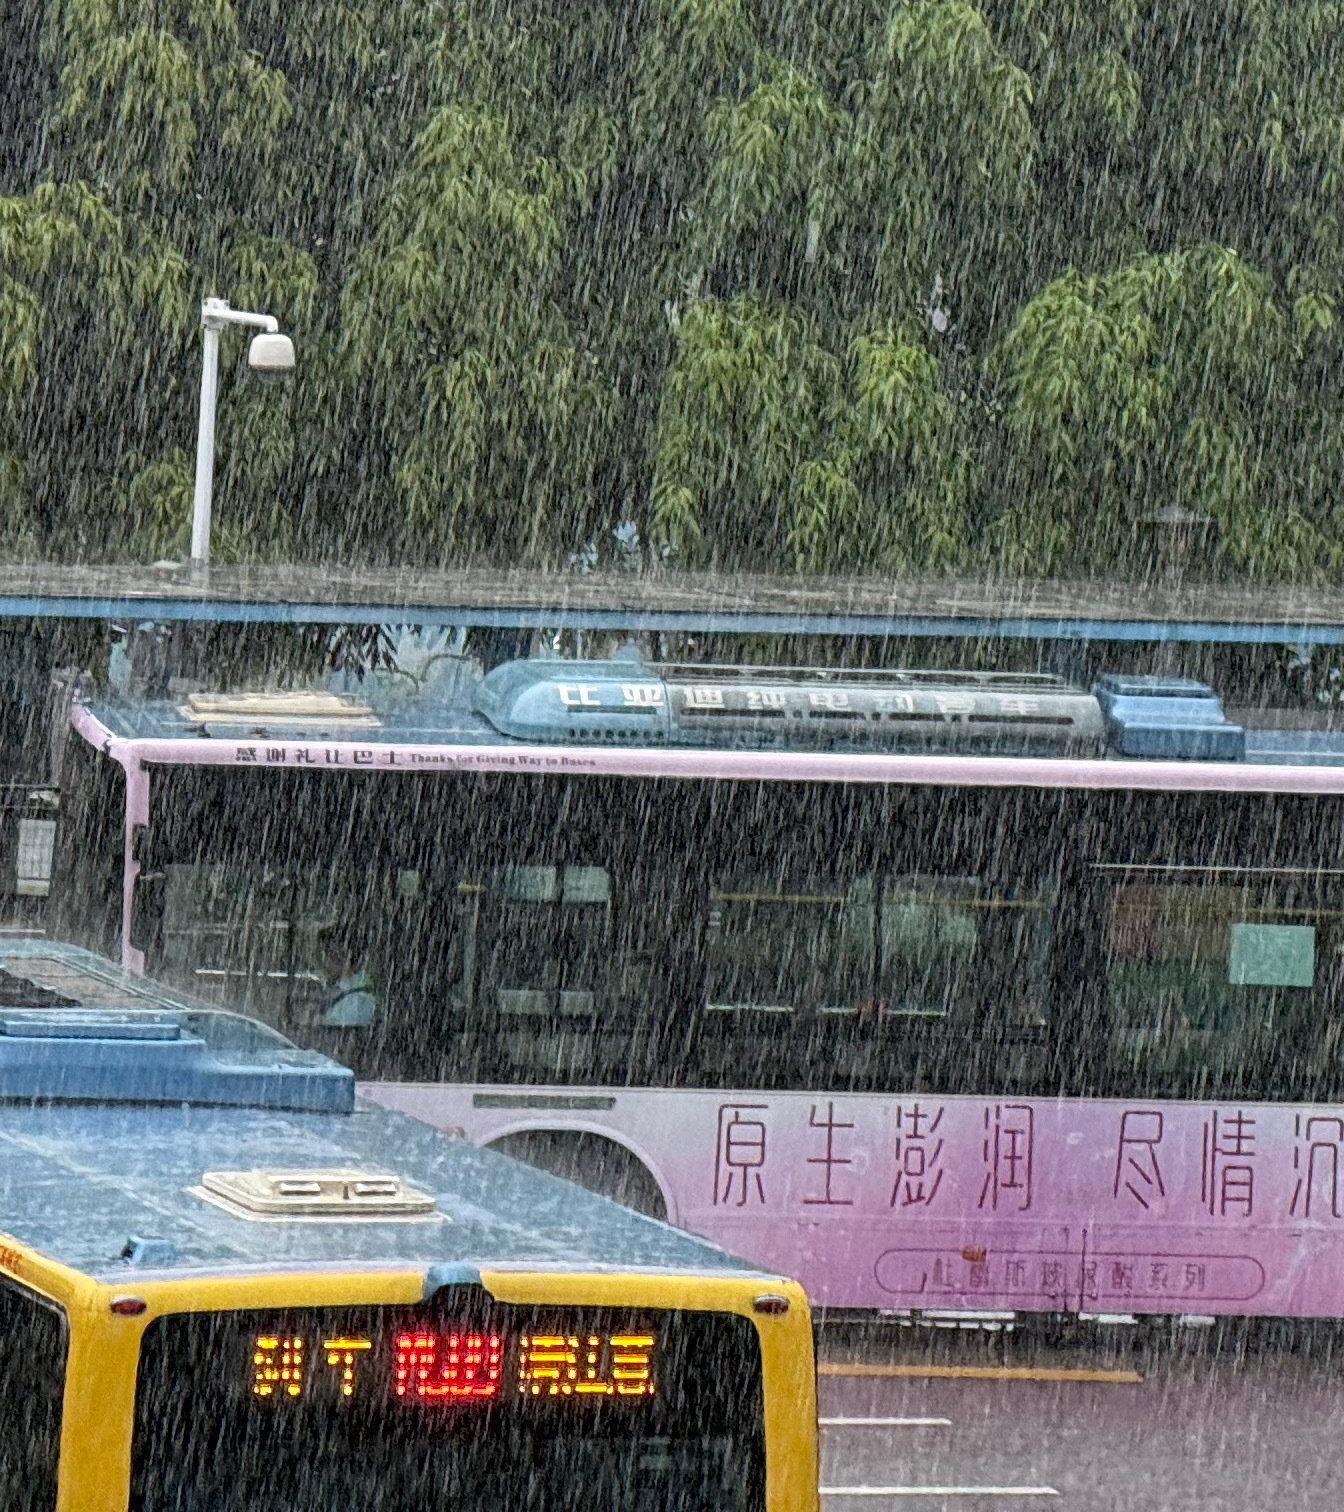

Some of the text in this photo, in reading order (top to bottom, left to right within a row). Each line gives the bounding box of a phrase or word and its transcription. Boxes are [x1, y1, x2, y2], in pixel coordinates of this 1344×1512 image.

[235, 747, 403, 767] 感谢礼让巴士
[410, 753, 597, 768] Thanks for Giving Way to Buses
[713, 1101, 1034, 1211] 原生澎润
